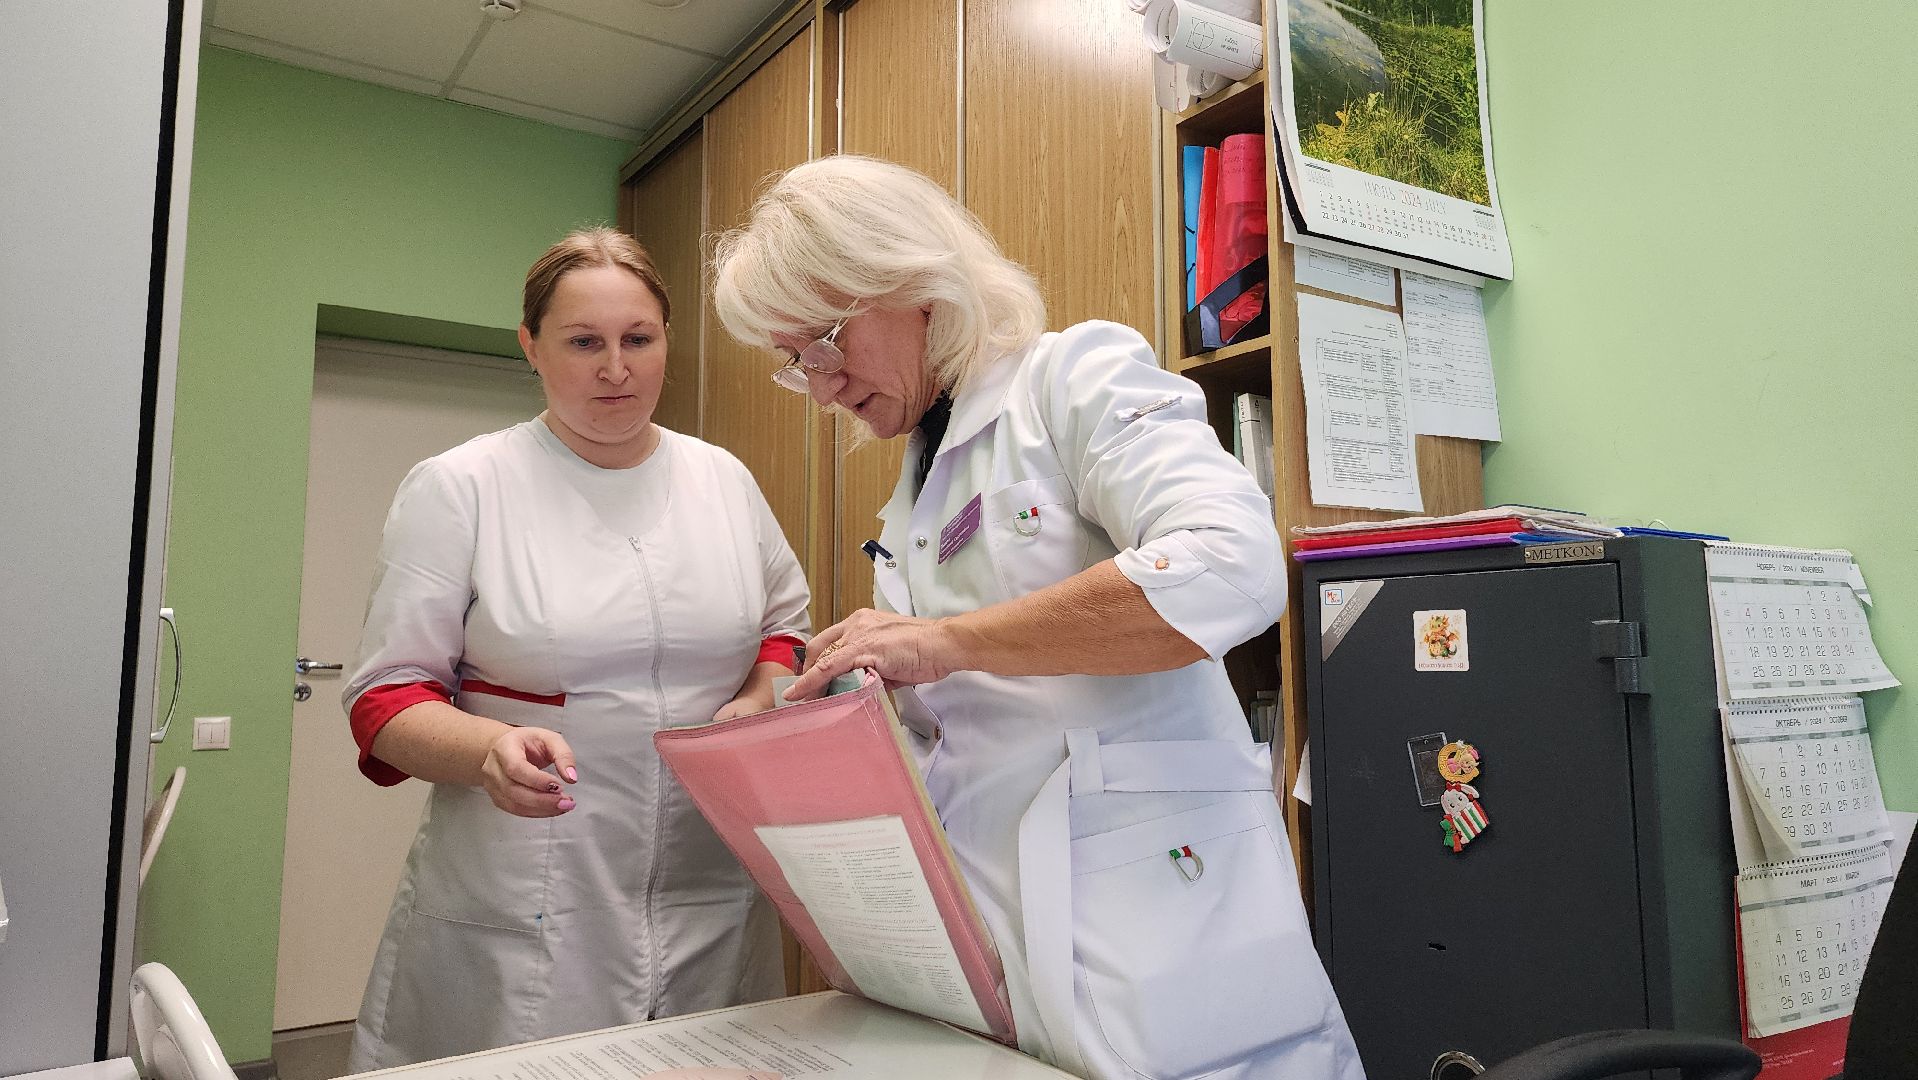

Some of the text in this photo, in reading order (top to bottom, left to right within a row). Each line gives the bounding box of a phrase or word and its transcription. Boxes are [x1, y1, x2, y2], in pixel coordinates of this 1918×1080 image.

[1399, 190, 1422, 207] 2024
[1532, 545, 1596, 560] METKON
[1807, 591, 1811, 601] 1
[1821, 591, 1826, 601] 2
[1762, 607, 1768, 619] 5
[1778, 608, 1784, 619] 6
[1795, 609, 1800, 620] 7
[1825, 609, 1831, 620] 9
[1746, 625, 1849, 638] 11 12 13 14 15 16 17
[1748, 646, 1760, 658] 18
[1766, 645, 1777, 658] 19
[1783, 645, 1794, 658] 20
[1800, 645, 1810, 657] 21
[1815, 645, 1826, 656] 22
[1831, 645, 1840, 656] 23
[1753, 666, 1765, 677] 25
[1771, 666, 1782, 677] 26
[1787, 665, 1797, 676] 27
[1820, 663, 1831, 675] 29
[1779, 746, 1784, 758] 1
[1797, 744, 1804, 756] 2
[1816, 743, 1822, 756] 3
[1834, 744, 1839, 754] 4
[1760, 768, 1766, 780] 7
[1780, 767, 1786, 777] 8
[1801, 764, 1806, 776] 9
[1816, 762, 1827, 775] 10
[1834, 762, 1842, 773] 11
[1764, 787, 1771, 799] 4
[1780, 786, 1792, 799] 15
[1800, 785, 1811, 796] 16
[1819, 782, 1828, 794] 17
[1781, 806, 1793, 818] 22
[1820, 802, 1832, 814] 24
[1838, 800, 1848, 812] 25
[1803, 824, 1816, 836] 30
[1822, 821, 1833, 833] 31
[1800, 878, 1817, 888] МАРТ
[1776, 933, 1782, 945] 4
[1795, 929, 1802, 942] 5
[1816, 927, 1823, 939] 6
[1836, 922, 1841, 935] 7
[1776, 953, 1786, 967] 11
[1797, 949, 1808, 963] 12
[1816, 946, 1828, 959] 13
[1836, 943, 1847, 956] 14
[1799, 970, 1811, 984] 19
[1818, 966, 1831, 980] 20
[1838, 963, 1848, 976] 21
[1781, 995, 1794, 1010] 25
[1801, 992, 1814, 1006] 26
[1820, 986, 1833, 1000] 27
